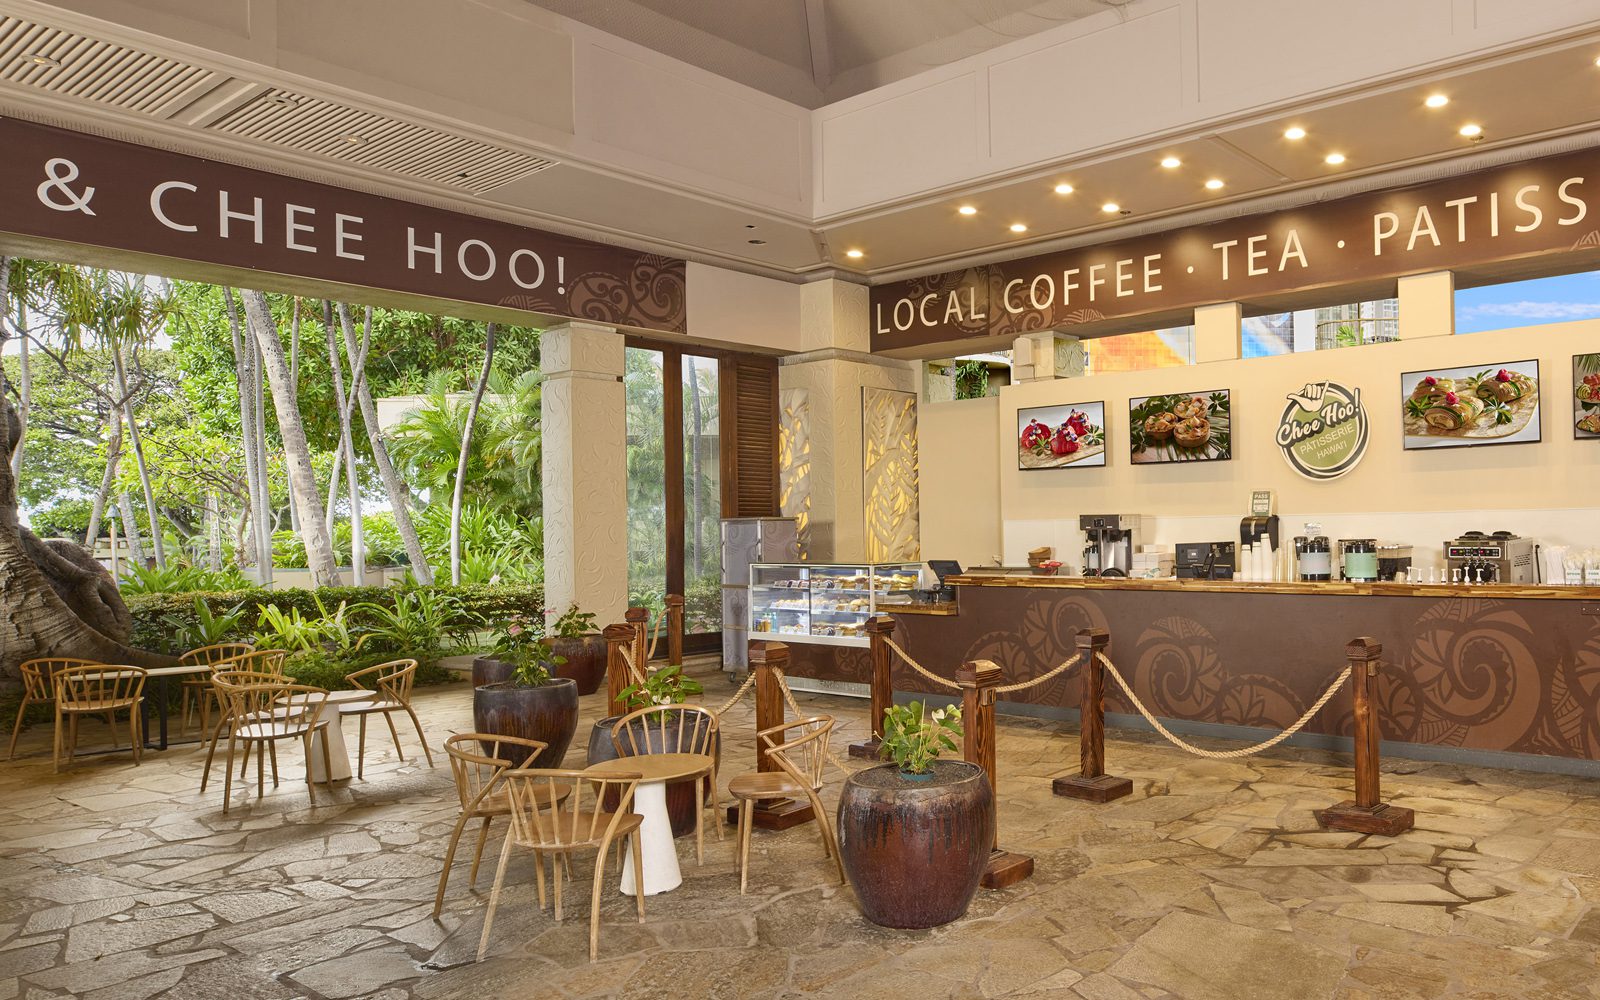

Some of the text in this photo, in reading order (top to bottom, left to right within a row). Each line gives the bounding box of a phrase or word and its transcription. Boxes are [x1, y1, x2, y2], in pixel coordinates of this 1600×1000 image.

[37, 157, 567, 295] & CHEE HOO!
[876, 177, 1588, 335] LOCAL COFFEE TEA PATISS
[1276, 387, 1361, 446] Chee Hoo!
